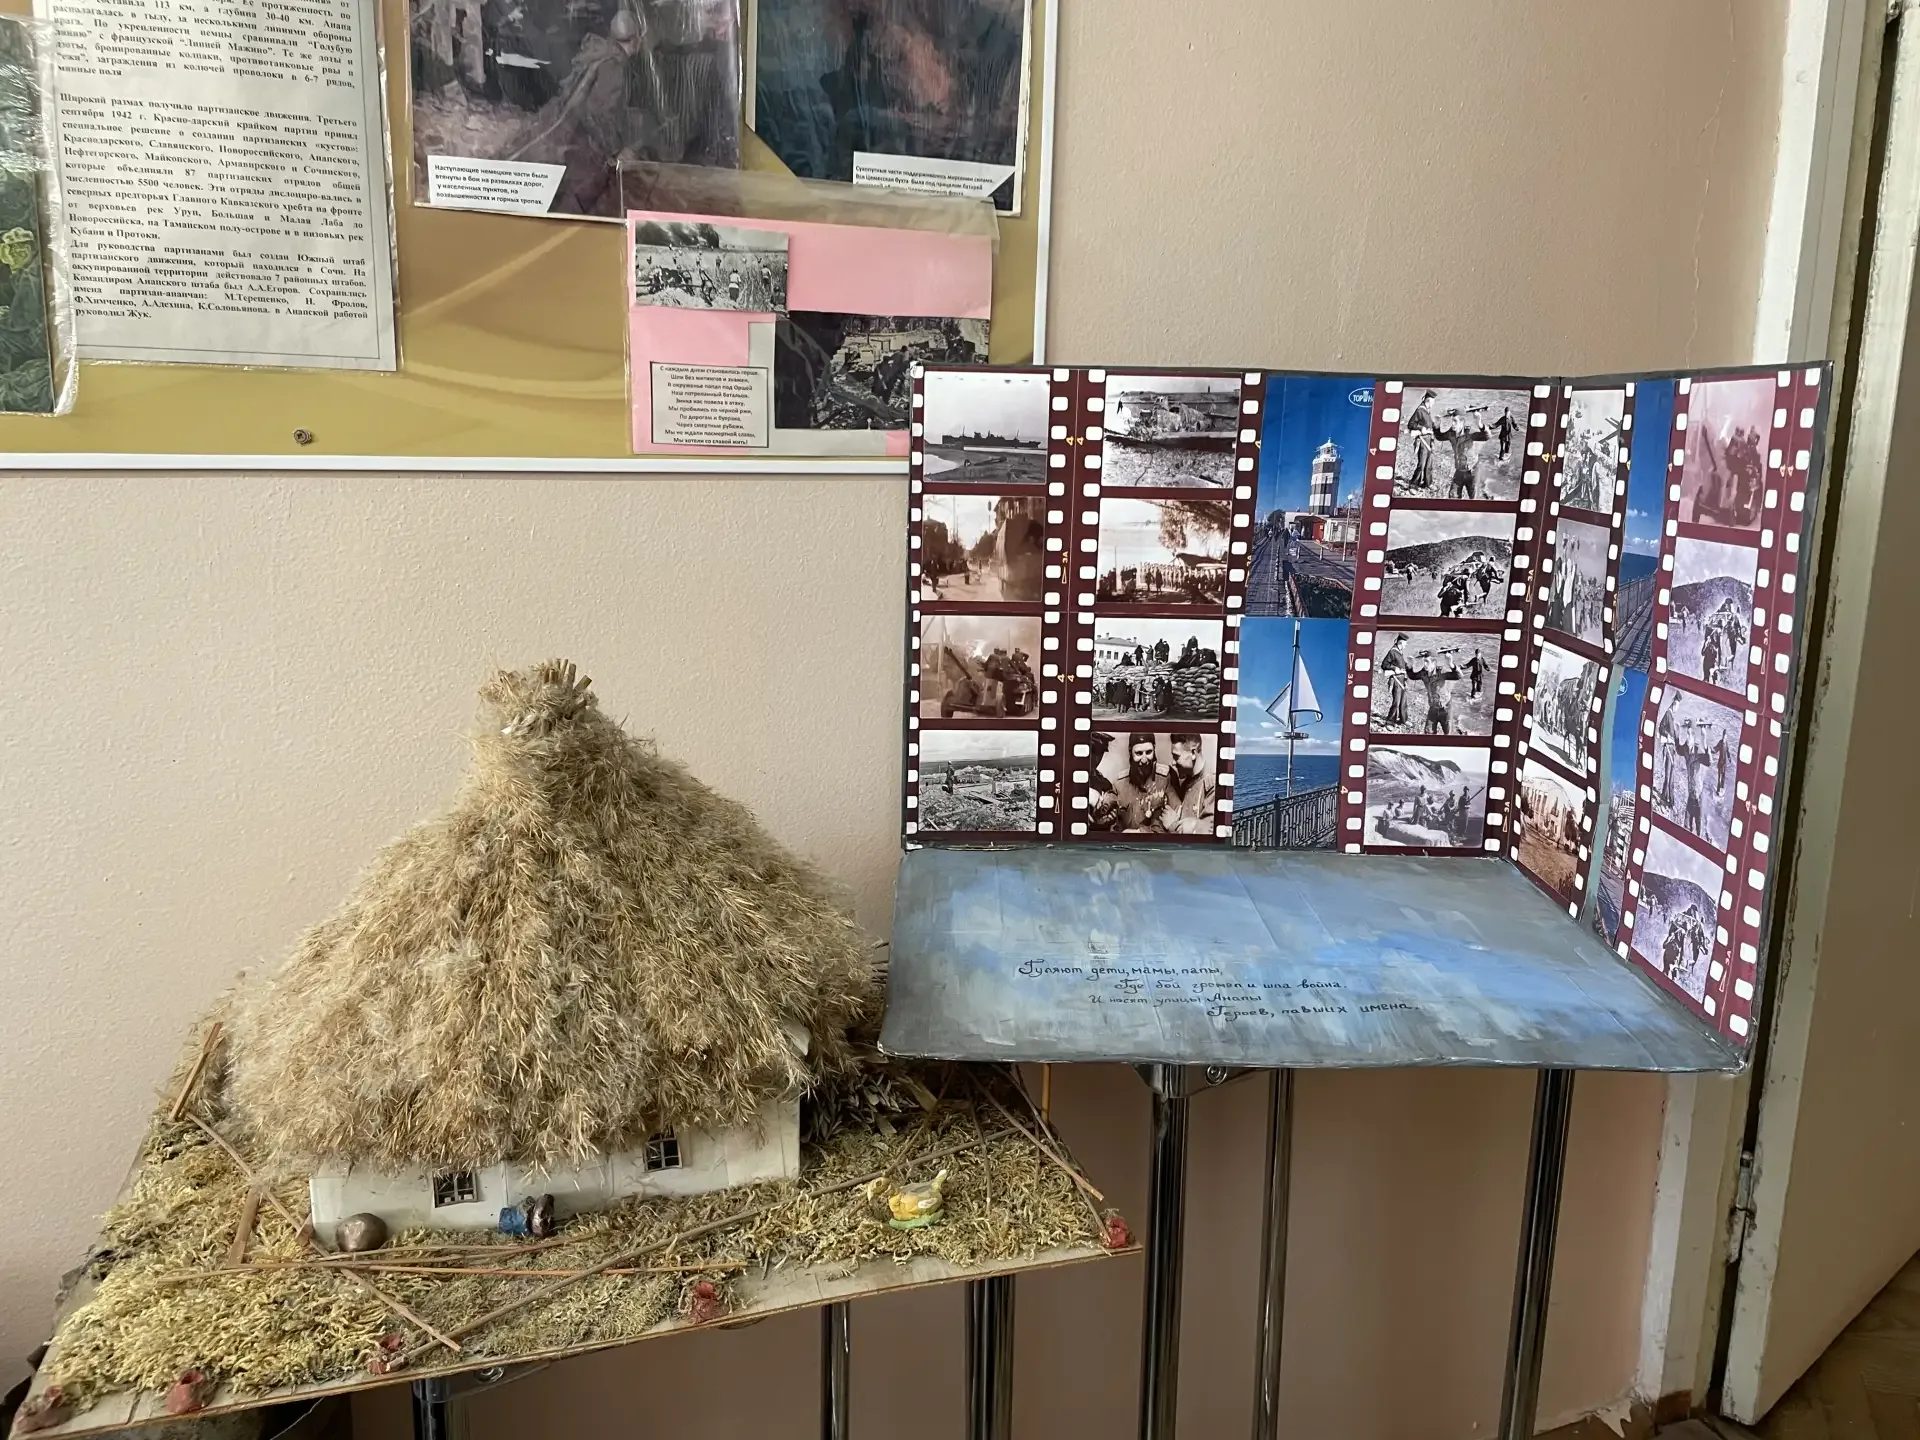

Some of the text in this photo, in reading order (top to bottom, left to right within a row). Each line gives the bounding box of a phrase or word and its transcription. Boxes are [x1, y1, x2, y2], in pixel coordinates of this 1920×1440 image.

[155, 0, 170, 9] 113
[218, 8, 257, 19] глубина
[266, 12, 290, 23] 30-40
[324, 21, 352, 32] Анапа
[60, 93, 106, 104] Широкий
[111, 98, 143, 107] размах
[148, 101, 192, 111] получило
[197, 105, 259, 117] партизанское
[316, 115, 356, 127] Третьего
[60, 108, 104, 119] сентября
[112, 110, 132, 119] 1942
[236, 122, 277, 132] крайком
[284, 126, 317, 136] партии
[324, 130, 357, 140] принял
[62, 122, 122, 132] специальное
[130, 126, 170, 136] решение
[192, 131, 234, 141] создании
[242, 135, 307, 148] партизанских
[218, 158, 285, 171] Армавирского
[65, 162, 360, 191] которые объединяли 87 партизанских отрядов общей
[66, 175, 134, 186] численностью
[138, 178, 158, 187] 5500
[207, 183, 225, 192] Эти
[230, 186, 264, 196] отряды
[66, 188, 112, 198] северных
[115, 191, 169, 202] предгорьях
[172, 193, 216, 204] Главного
[220, 197, 279, 209] Кавказского
[282, 203, 312, 212] хребта
[330, 205, 362, 216] фронте
[88, 203, 136, 212] верховьев
[147, 206, 163, 215] рек
[211, 209, 254, 220] Большая
[280, 214, 311, 225] Малая
[320, 217, 343, 227] Лаба
[353, 221, 363, 229] до
[70, 226, 104, 236] Кубани
[147, 219, 159, 227] на
[162, 219, 216, 230] Таманском
[303, 230, 344, 240] низовьях
[348, 234, 364, 242] рек
[71, 252, 299, 272] партизанского который находился
[153, 268, 272, 281] территории действовало
[1018, 959, 1223, 981] Гуляют дети, мамы, папы,
[1114, 978, 1145, 994] Где
[1156, 979, 1181, 989] бой
[1297, 979, 1347, 989] война.
[1089, 995, 1102, 1004] И
[1153, 997, 1201, 1007] улицы
[1207, 993, 1262, 1002] Анапы
[1207, 1006, 1275, 1022] Героев,
[1360, 1003, 1419, 1013] имена.
